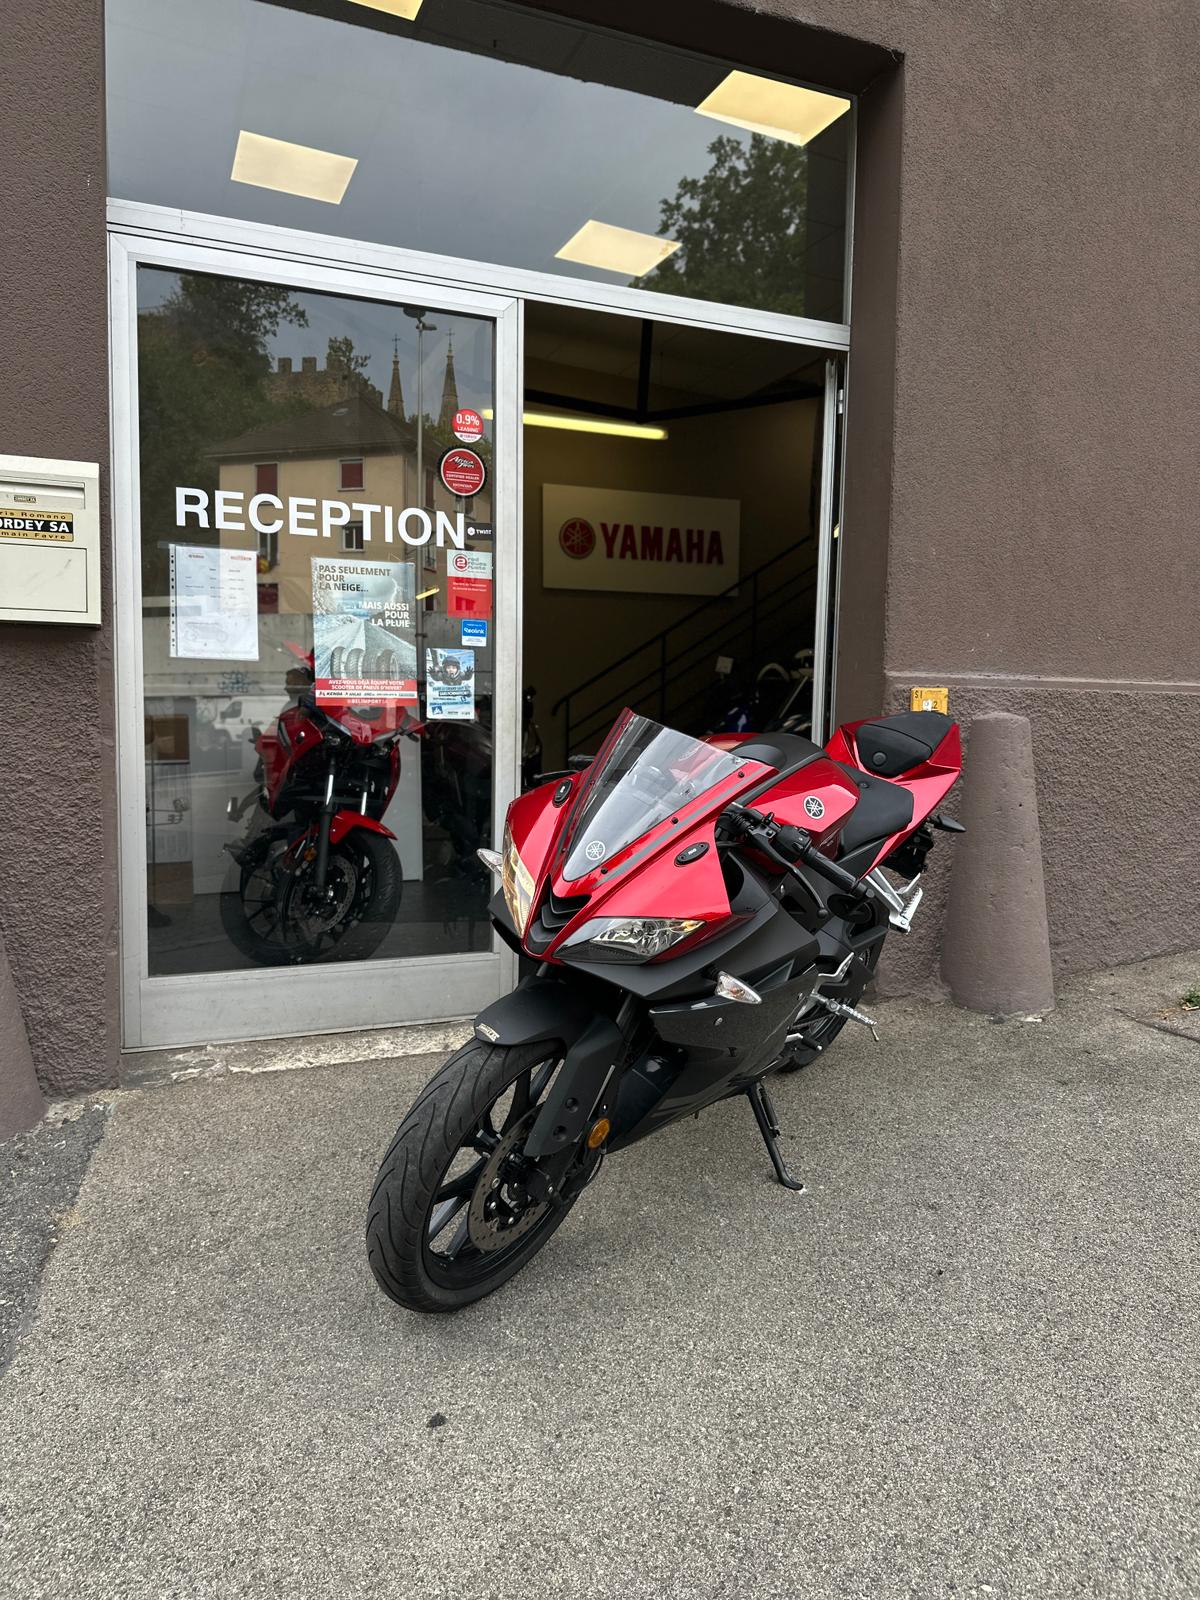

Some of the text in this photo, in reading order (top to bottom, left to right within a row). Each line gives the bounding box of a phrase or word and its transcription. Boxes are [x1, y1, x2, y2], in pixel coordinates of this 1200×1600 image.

[456, 413, 480, 425] 0.9%
[175, 486, 465, 549] RECEPTION
[49, 521, 69, 533] SA
[600, 522, 724, 566] YAMAHA
[318, 565, 391, 577] PAS SEULEMENT
[319, 573, 345, 583] POUR
[319, 581, 332, 591] LA
[383, 601, 409, 611] AUSSI
[384, 610, 410, 620] POUR
[371, 617, 411, 628] LA PLUIE
